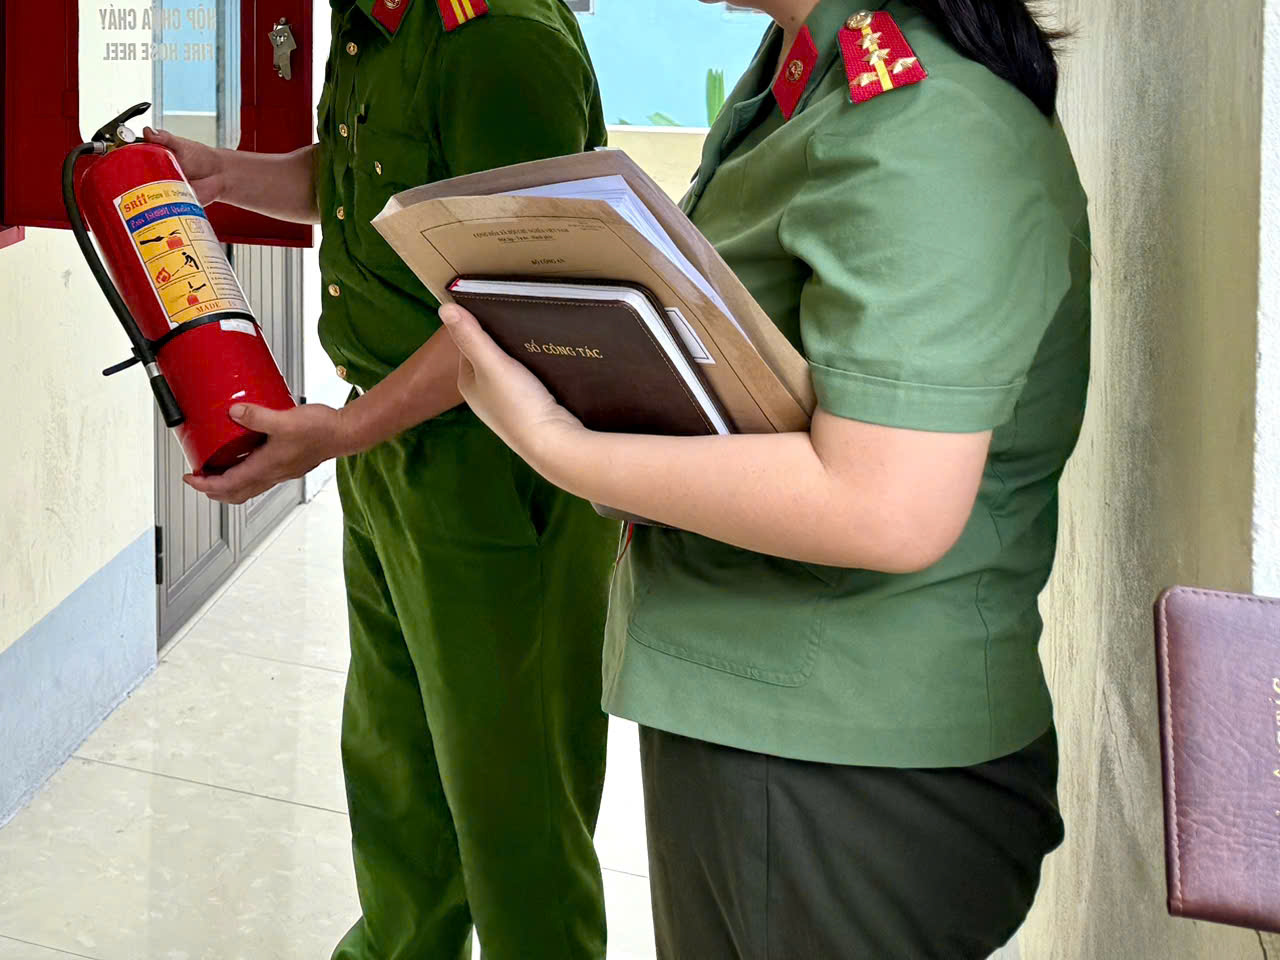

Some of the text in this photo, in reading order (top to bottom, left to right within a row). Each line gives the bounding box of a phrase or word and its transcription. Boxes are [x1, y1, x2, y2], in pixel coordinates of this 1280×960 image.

[195, 300, 221, 313] MADE
[542, 342, 577, 357] CÔNG
[575, 345, 603, 359] TÁC
